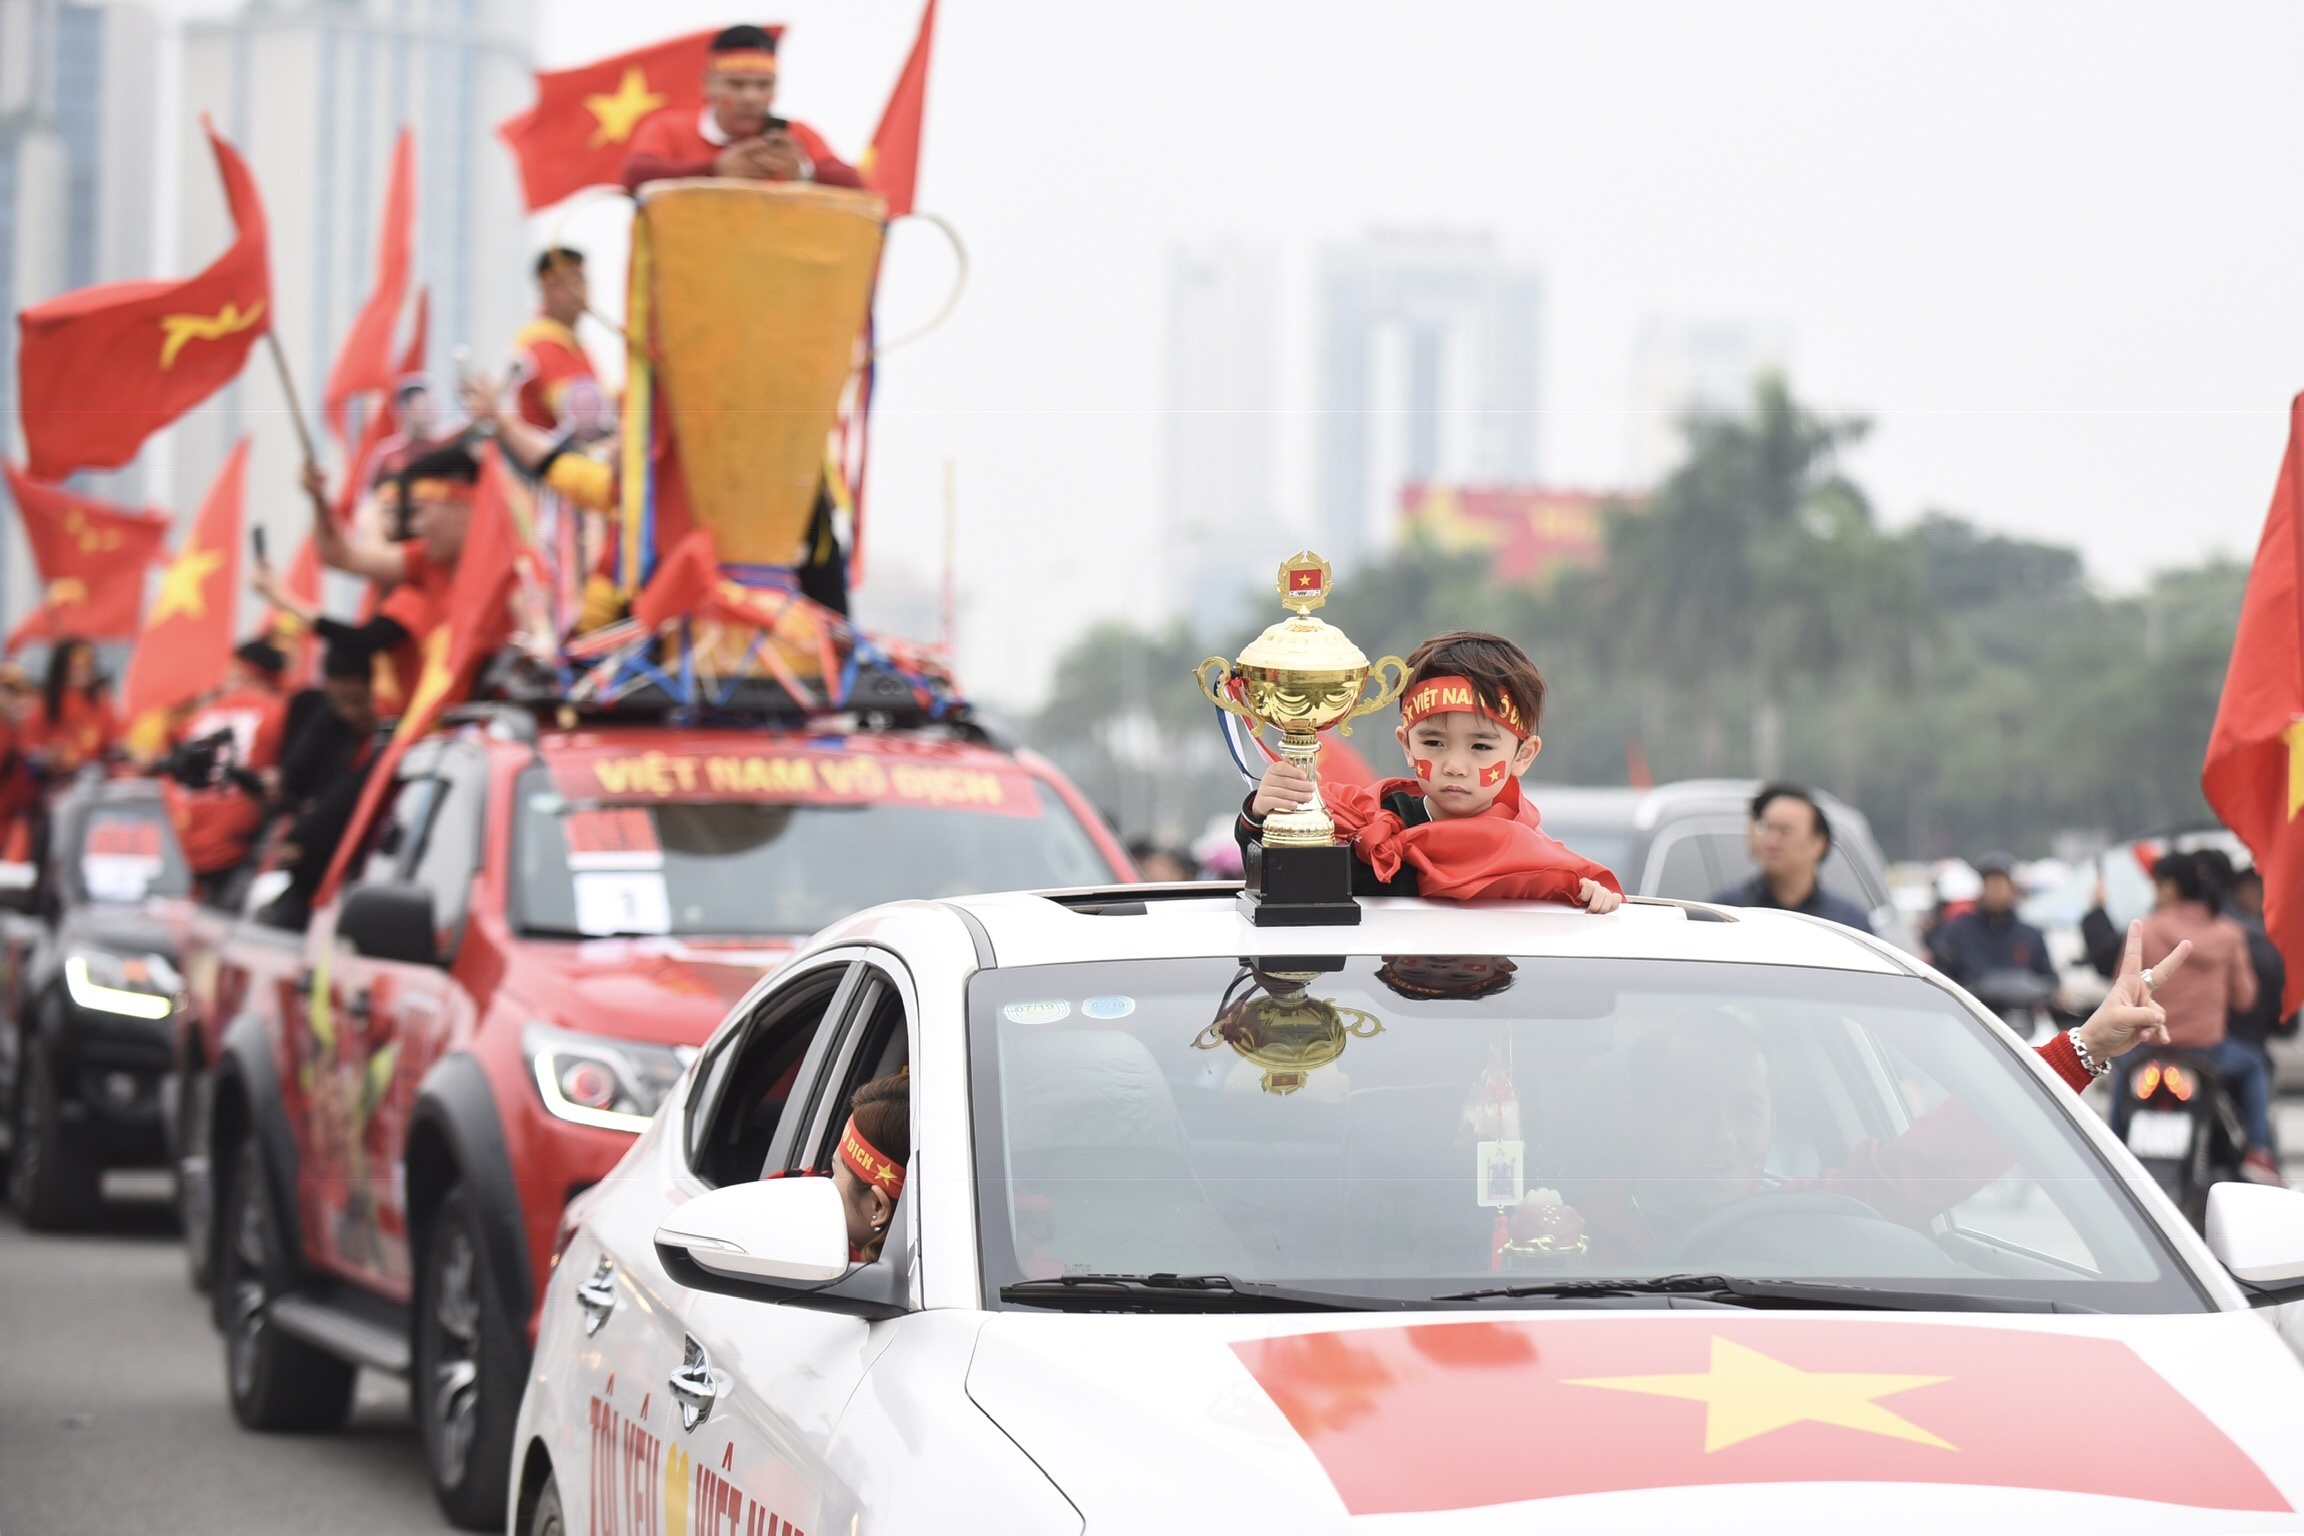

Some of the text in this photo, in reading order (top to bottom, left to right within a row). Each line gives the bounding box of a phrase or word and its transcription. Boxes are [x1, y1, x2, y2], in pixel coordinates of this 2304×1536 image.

[1412, 686, 1438, 714] VIỆT
[594, 750, 698, 798] VIỆT
[704, 756, 819, 794] NAM
[847, 1137, 874, 1171] ĐỊCH
